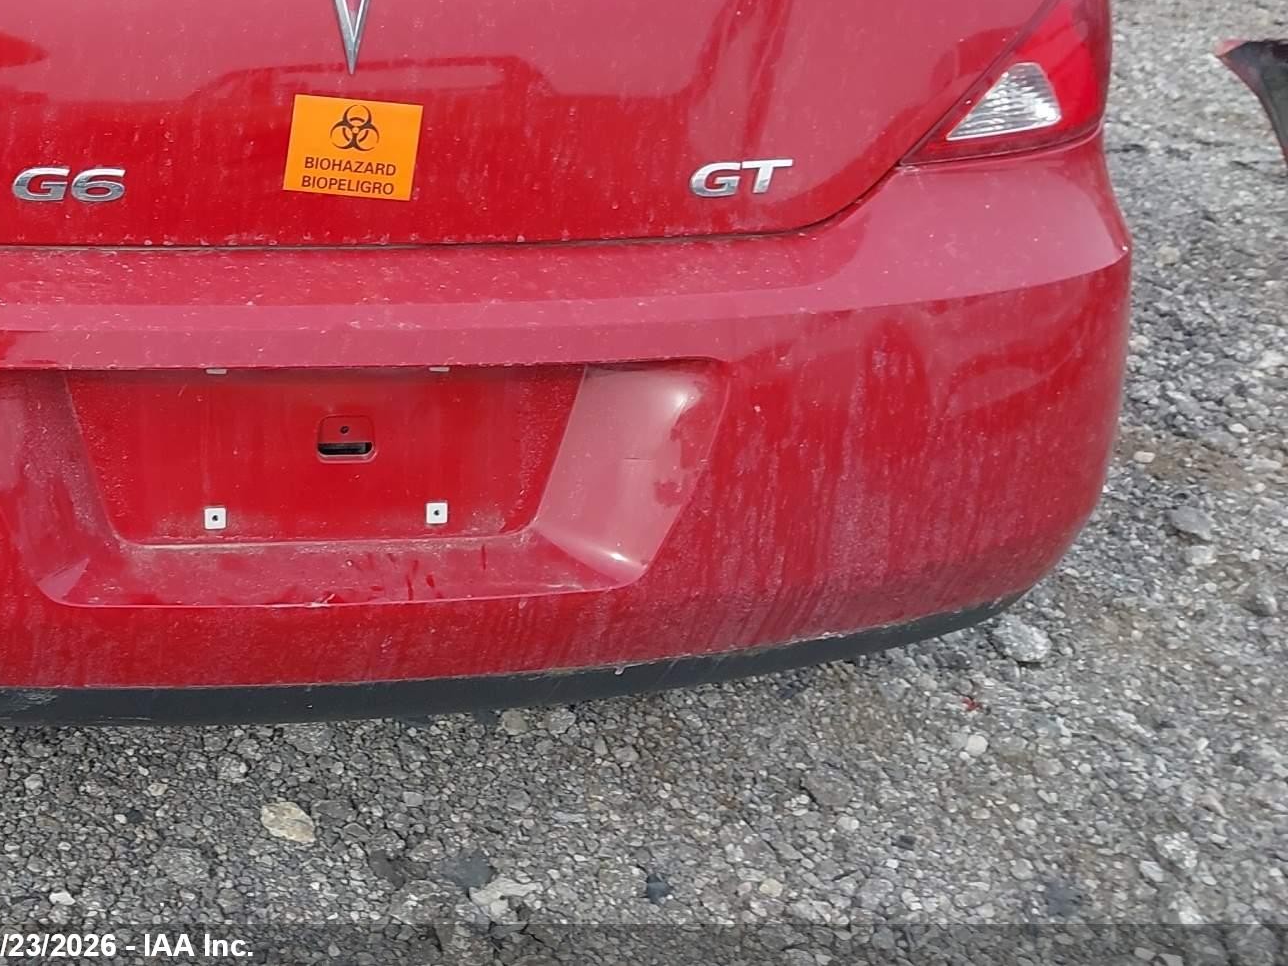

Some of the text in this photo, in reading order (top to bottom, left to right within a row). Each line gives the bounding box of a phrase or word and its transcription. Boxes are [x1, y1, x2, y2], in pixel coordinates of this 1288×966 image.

[304, 156, 397, 176] BIOHAZARD
[690, 159, 793, 197] GT
[14, 167, 126, 202] G6
[301, 175, 395, 195] BIOPELIGRO
